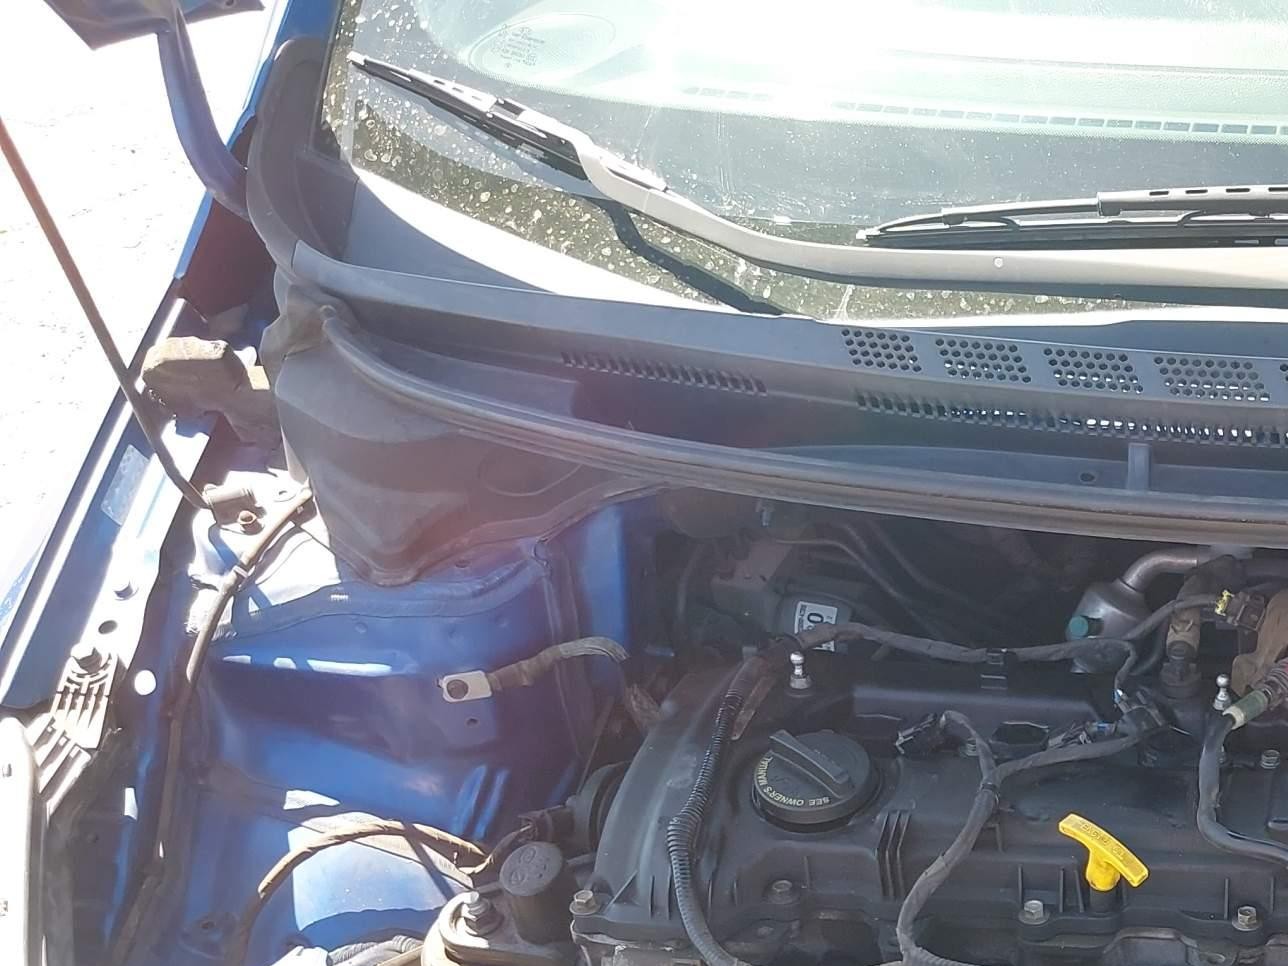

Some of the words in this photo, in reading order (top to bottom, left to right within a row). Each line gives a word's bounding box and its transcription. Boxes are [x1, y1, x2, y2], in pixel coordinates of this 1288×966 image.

[757, 757, 773, 786] MANUAL
[763, 786, 805, 806] OWNER'S
[808, 797, 830, 806] SEE
